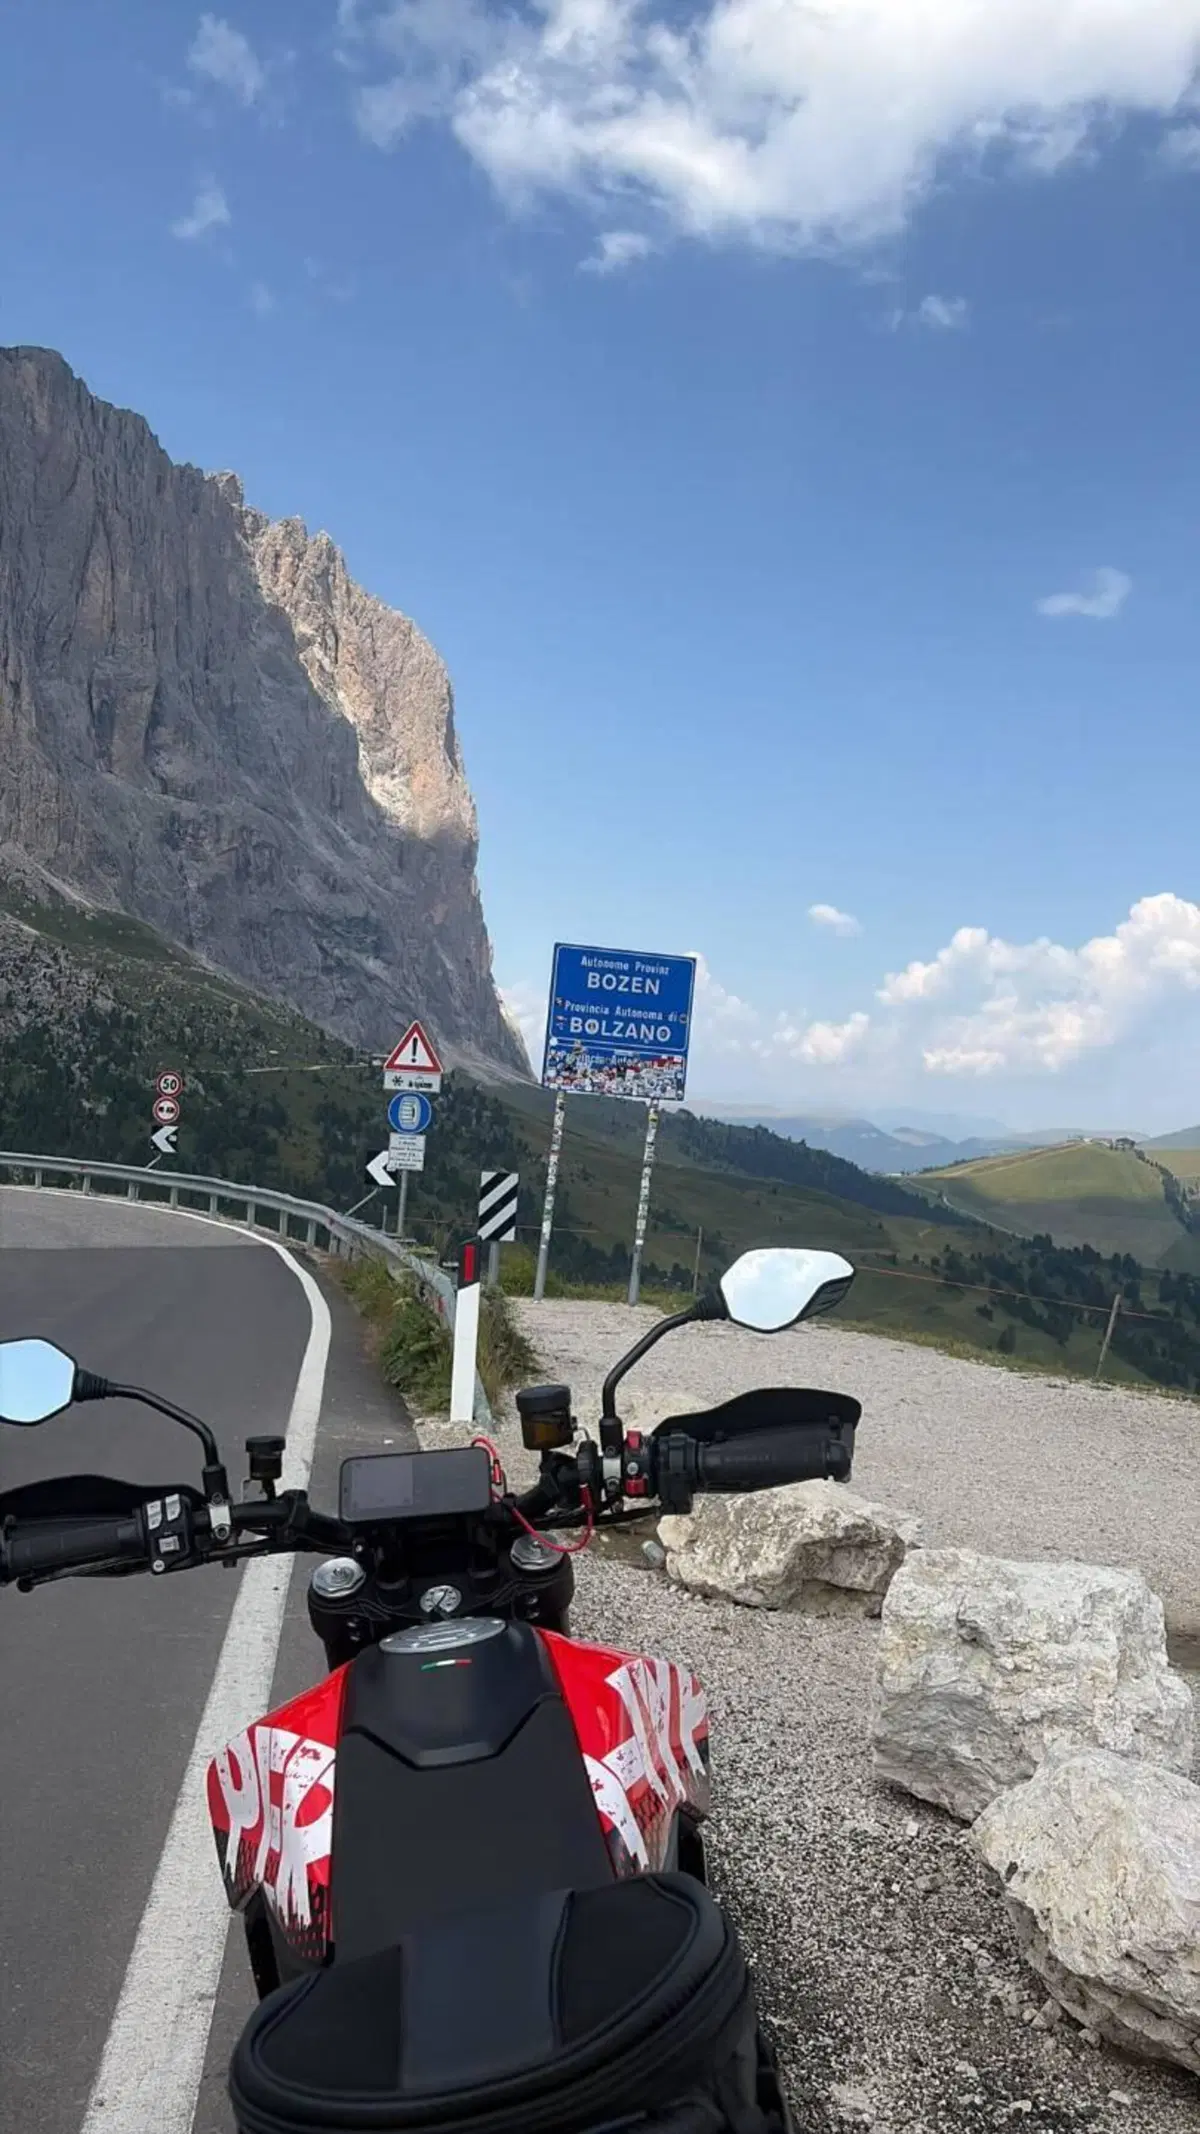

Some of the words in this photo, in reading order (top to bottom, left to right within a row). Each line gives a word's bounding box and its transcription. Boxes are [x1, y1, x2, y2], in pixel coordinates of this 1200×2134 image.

[580, 955, 629, 971] Autonome
[635, 961, 669, 976] Provinz
[587, 971, 660, 995] BOZEN
[564, 1000, 610, 1015] Provincia
[615, 1005, 663, 1020] Autonoma
[668, 1012, 677, 1022] di
[569, 1016, 671, 1042] BOLZANO
[162, 1078, 177, 1090] 50
